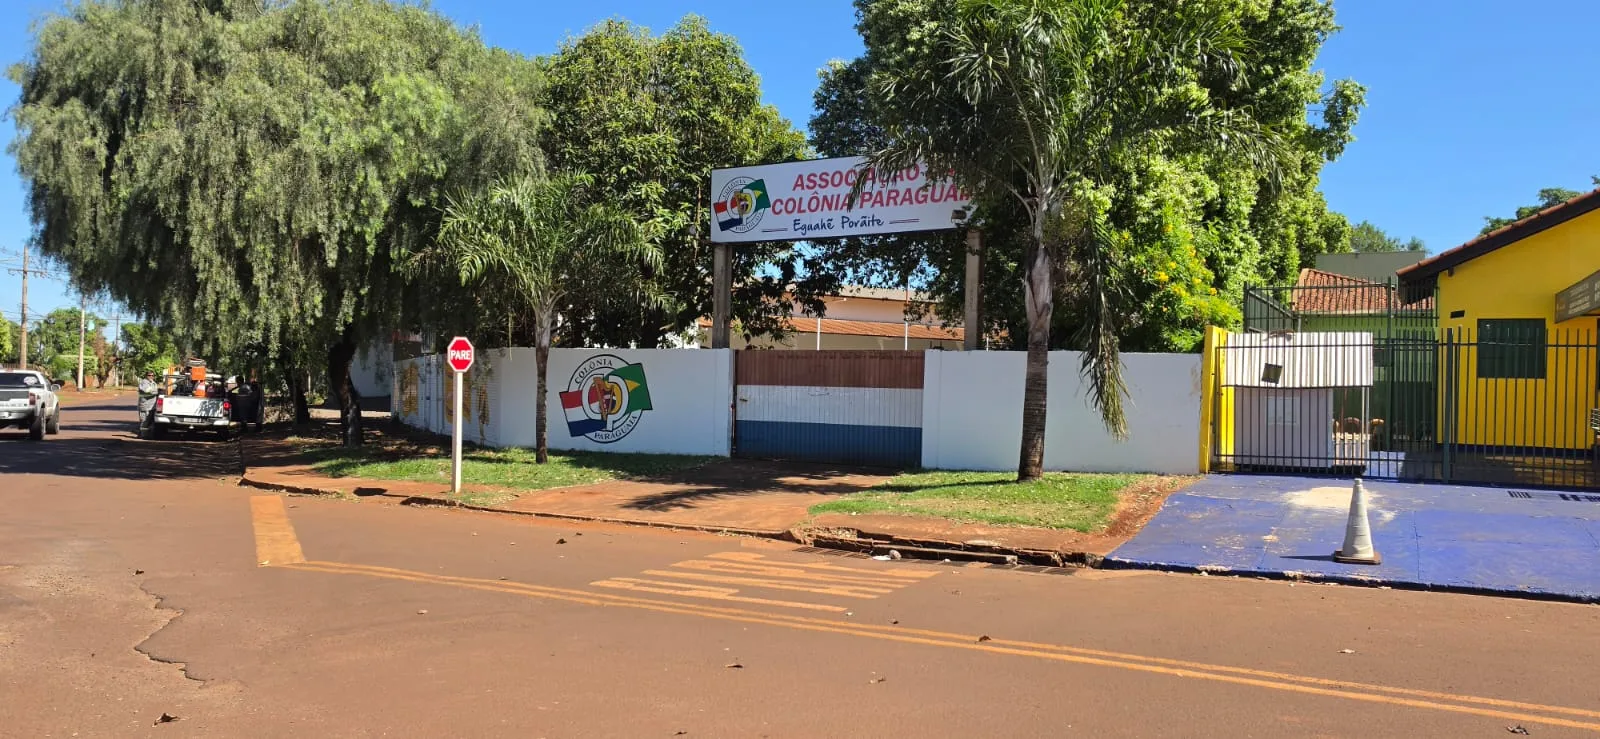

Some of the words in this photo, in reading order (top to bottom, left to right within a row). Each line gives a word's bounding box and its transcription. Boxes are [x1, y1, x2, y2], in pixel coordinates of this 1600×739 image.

[792, 163, 920, 191] ASSOCAÇÃO
[771, 192, 853, 216] COLÔNIA
[450, 349, 471, 360] PARE
[575, 358, 613, 384] COLÔNIA
[594, 415, 637, 440] PARAGUAIA
